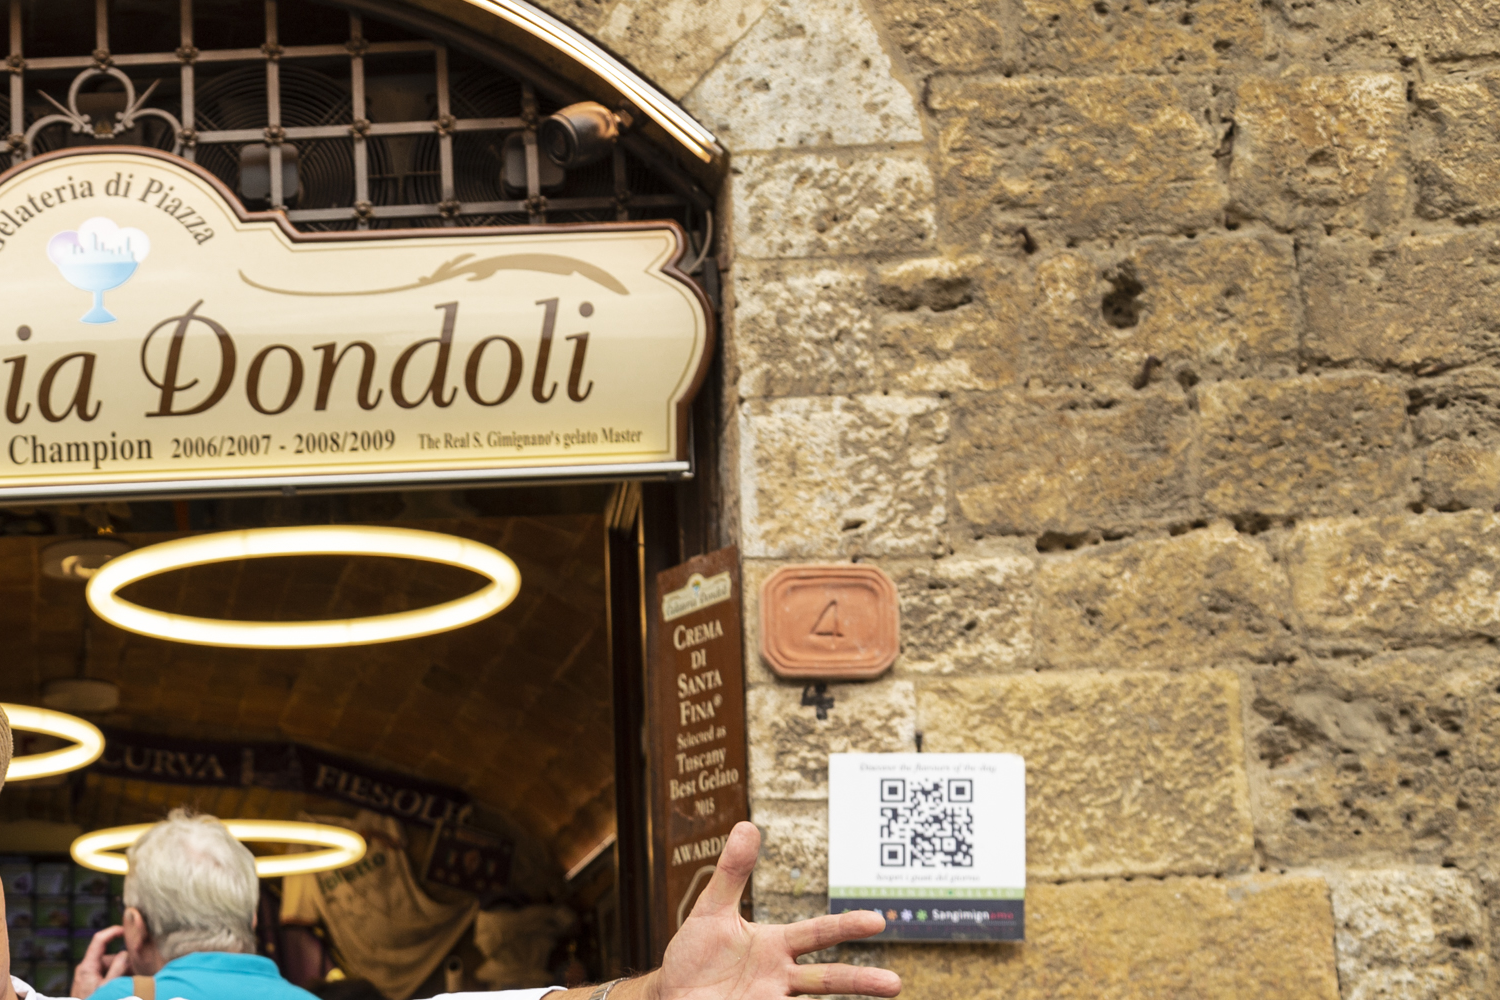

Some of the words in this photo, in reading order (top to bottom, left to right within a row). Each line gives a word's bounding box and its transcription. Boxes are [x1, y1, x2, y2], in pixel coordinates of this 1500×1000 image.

[105, 172, 134, 198] di
[138, 177, 216, 246] Piazza
[141, 299, 596, 420] Dondoli
[8, 431, 154, 470] Champion
[171, 434, 272, 459] 2006/2007
[294, 429, 396, 454] 2008/2009
[418, 433, 440, 450] The
[443, 432, 470, 449] Real
[473, 432, 484, 449] S.
[487, 430, 561, 452] Gimignano's
[563, 430, 599, 449] gelato
[601, 427, 643, 445] Master
[673, 619, 724, 650] CREMA
[691, 649, 706, 670] DI
[677, 669, 722, 699] SANTA
[677, 728, 714, 750] Selected
[715, 725, 727, 740] as
[100, 744, 226, 780] CURVA
[675, 747, 727, 774] Tuscany
[669, 778, 696, 801] Best
[699, 767, 739, 793] Gelato
